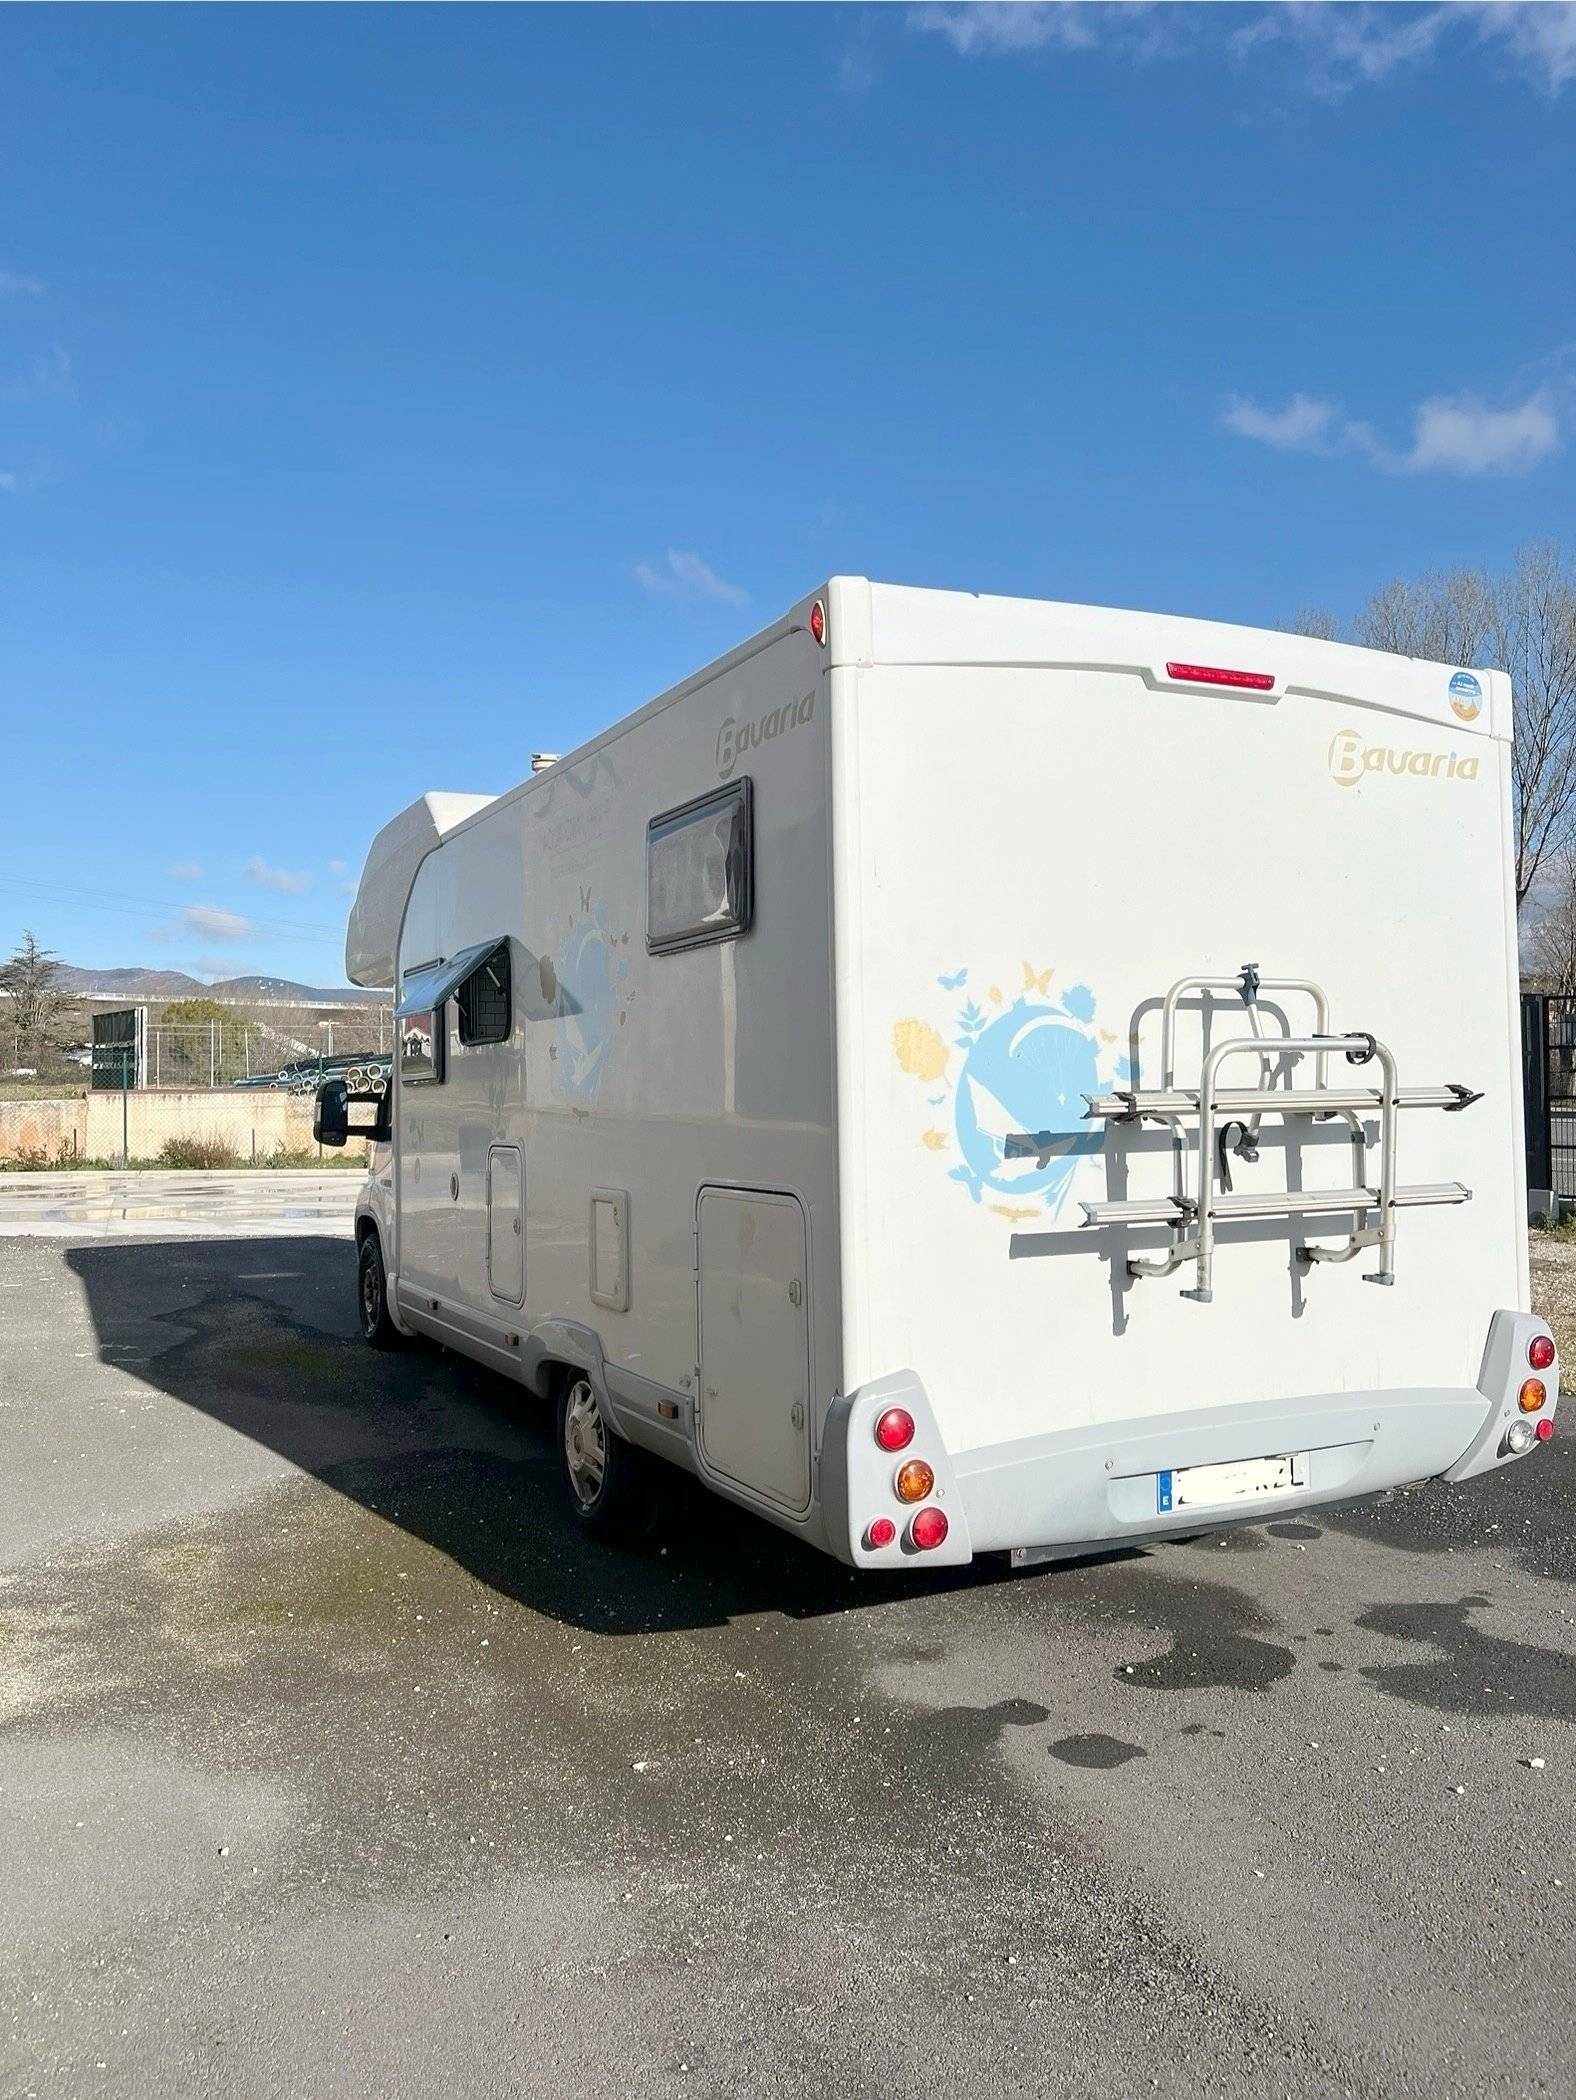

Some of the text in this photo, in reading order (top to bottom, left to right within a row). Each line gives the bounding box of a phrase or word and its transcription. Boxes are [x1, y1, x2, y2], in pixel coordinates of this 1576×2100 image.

[716, 690, 815, 779] Bavaria
[1328, 729, 1480, 787] Bavaria
[1162, 1495, 1169, 1505] E
